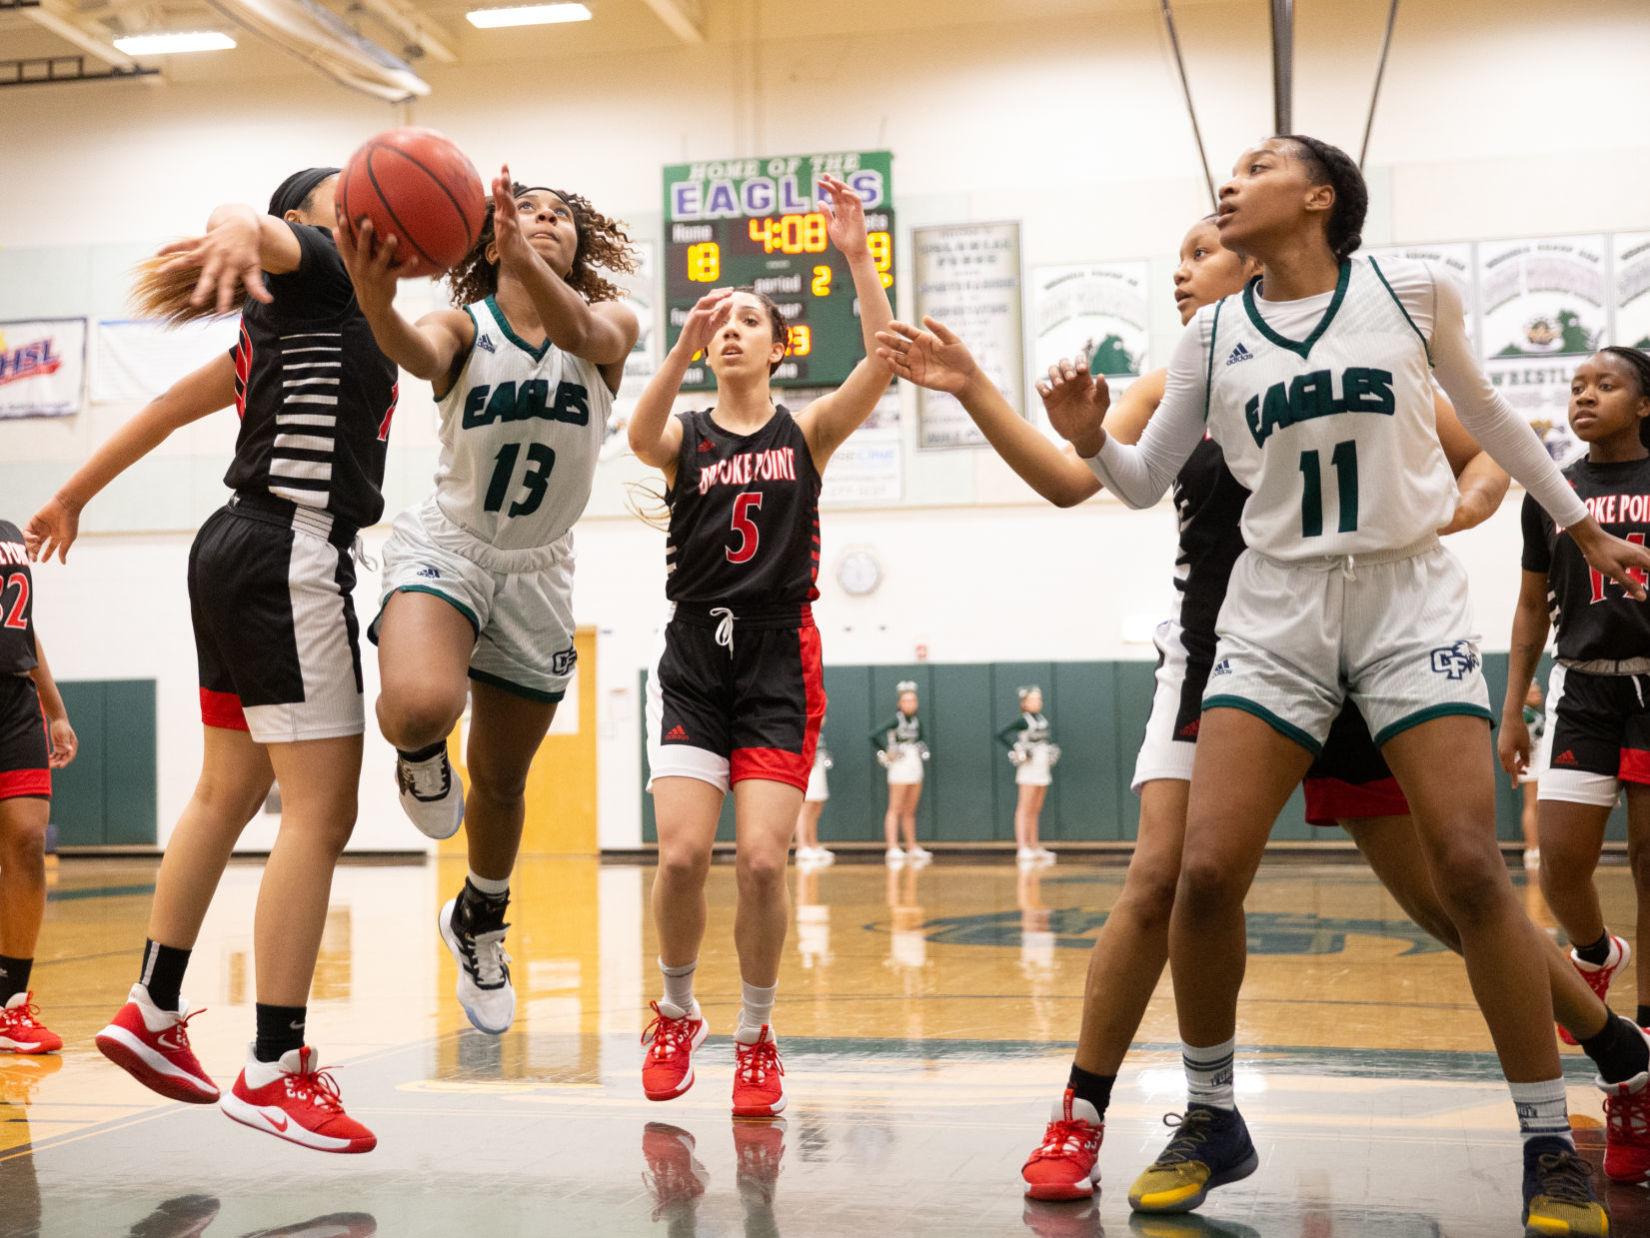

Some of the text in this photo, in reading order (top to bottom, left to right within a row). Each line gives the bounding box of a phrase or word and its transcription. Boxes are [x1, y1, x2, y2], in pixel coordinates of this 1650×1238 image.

[689, 153, 861, 181] HOME OF THE
[671, 170, 884, 219] EAGLES
[748, 212, 828, 254] 4:08
[687, 242, 720, 282] 18
[811, 264, 832, 297] 2
[1226, 352, 1253, 366] adidas
[462, 379, 589, 430] EAGLES
[1245, 367, 1395, 449] EAGLES
[484, 442, 556, 519] 13
[754, 446, 797, 481] POINT
[1299, 440, 1358, 538] 11
[725, 491, 763, 564] 5
